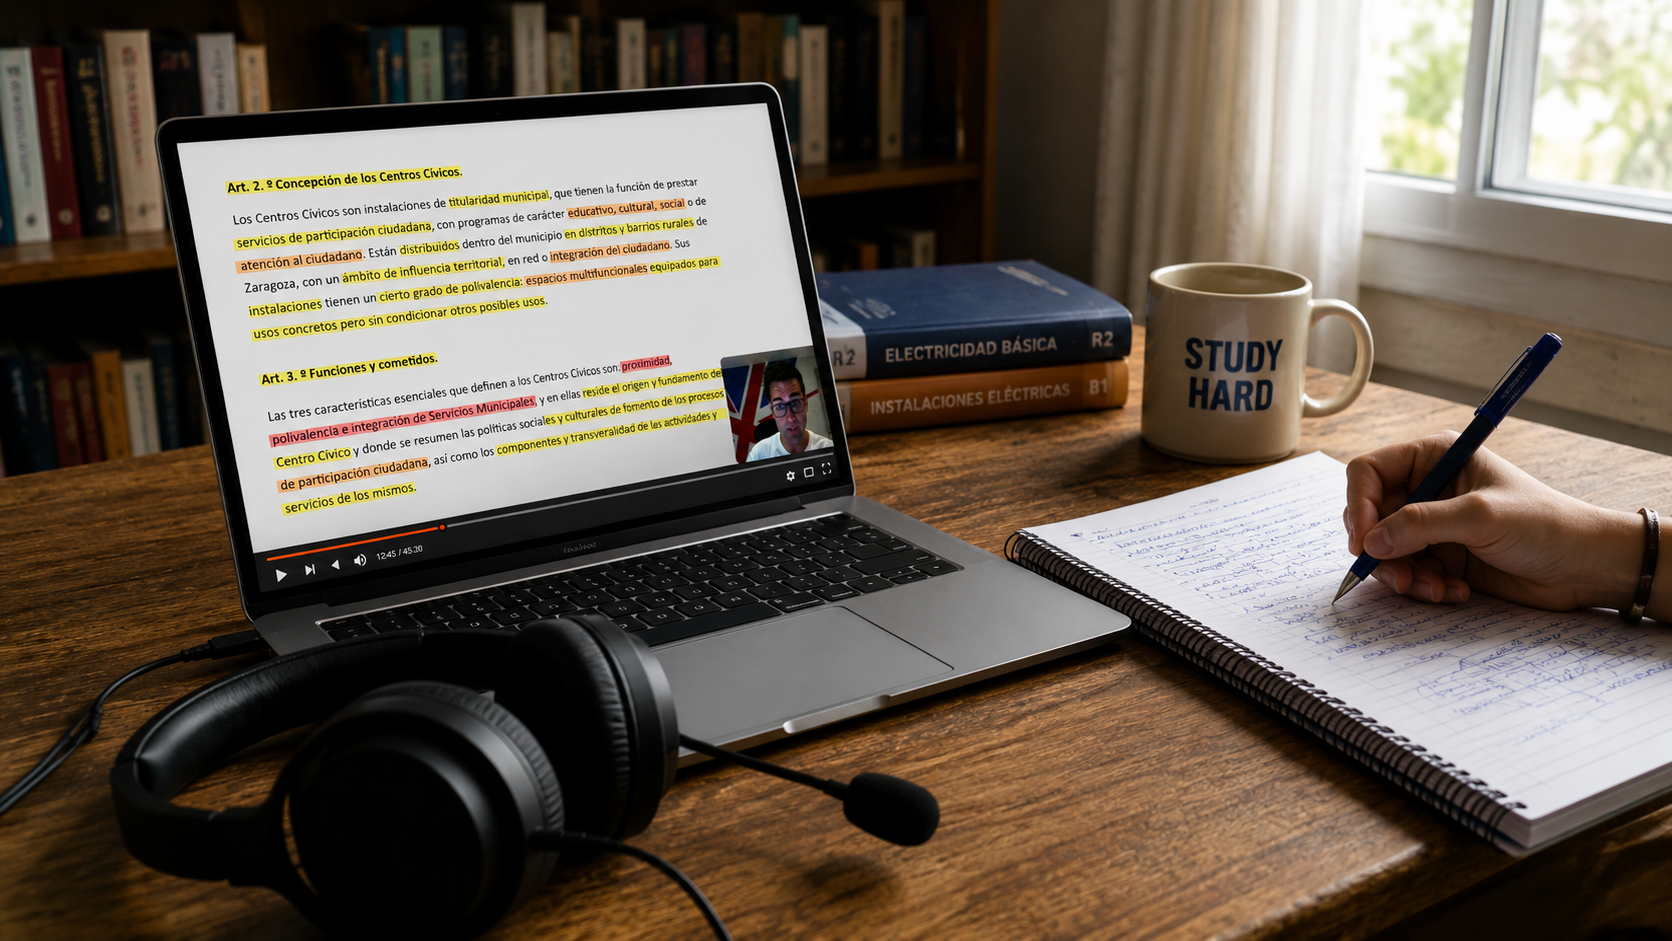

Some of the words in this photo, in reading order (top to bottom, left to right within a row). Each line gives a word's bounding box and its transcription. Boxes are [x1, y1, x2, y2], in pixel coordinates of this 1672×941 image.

[227, 181, 250, 194] Art.
[251, 180, 264, 192] 2.
[274, 174, 342, 190] Concepción
[343, 173, 359, 185] de
[359, 172, 378, 184] los
[378, 170, 422, 182] Centros
[232, 214, 253, 226] Los
[254, 211, 300, 224] Centros
[341, 206, 362, 217] son
[363, 200, 432, 214] instalaciones
[432, 197, 447, 209] de
[447, 192, 501, 207] titularidad
[501, 189, 553, 203] municipal,
[553, 189, 573, 201] que
[573, 186, 604, 197] tienen
[604, 183, 615, 194] la
[615, 180, 651, 193] función
[652, 179, 665, 190] de
[665, 178, 698, 191] prestar
[236, 234, 286, 249] servicios
[287, 232, 303, 244] de
[304, 225, 376, 245] participación
[377, 221, 435, 235] ciudadana,
[436, 220, 456, 230] con
[457, 215, 511, 231] programas
[511, 212, 525, 223] de
[525, 209, 566, 222] carácter
[567, 205, 617, 218] educativo,
[618, 200, 658, 213] cultural,
[659, 198, 685, 210] social
[686, 199, 694, 207] o
[694, 196, 707, 206] de
[240, 256, 291, 271] atención
[292, 254, 303, 266] al
[304, 250, 366, 265] ciudadano.
[367, 245, 397, 259] Están
[399, 240, 460, 255] distribuidos
[461, 237, 496, 250] dentro
[497, 233, 514, 246] del
[514, 230, 563, 244] municipio
[563, 230, 577, 239] en
[618, 225, 625, 236] y
[625, 221, 661, 233] barrios
[661, 217, 695, 230] rurales
[695, 215, 708, 226] de
[243, 279, 300, 294] Zaragoza,
[301, 277, 323, 288] con
[324, 275, 340, 285] un
[341, 269, 381, 283] ámbito
[383, 267, 398, 279] de
[399, 262, 451, 277] influencia
[452, 255, 506, 272] territorial,
[506, 256, 521, 266] en
[521, 252, 540, 264] red
[540, 253, 549, 263] o
[549, 246, 604, 262] integración
[605, 244, 621, 256] del
[622, 241, 673, 254] ciudadano.
[673, 238, 691, 249] Sus
[248, 300, 323, 316] instalaciones
[323, 295, 361, 308] tienen
[362, 294, 377, 304] un
[378, 290, 411, 302] cierto
[412, 285, 443, 301] grado
[444, 283, 459, 295] de
[460, 277, 523, 295] polivalencia:
[525, 272, 568, 287] espacios
[568, 263, 648, 281] multifuncionales
[649, 258, 697, 273] equipados
[697, 257, 719, 269] para
[253, 328, 280, 339] usos
[282, 321, 338, 336] concretos
[339, 318, 366, 332] pero
[367, 314, 384, 327] sin
[385, 308, 448, 324] condicionar
[449, 304, 478, 316] otros
[478, 298, 521, 315] posibles
[521, 297, 549, 308] usos.
[1091, 330, 1114, 348] R2
[261, 373, 284, 385] Art.
[285, 370, 298, 382] 3.
[308, 363, 367, 379] Funciones
[368, 362, 376, 374] y
[377, 353, 438, 370] cometidos.
[885, 341, 997, 363] ELECTRICIDAD
[1001, 335, 1058, 355] BÁSICA
[1184, 337, 1283, 373] STUDY
[267, 411, 287, 422] Las
[287, 407, 312, 419] tres
[393, 387, 448, 405] esenciales
[448, 385, 469, 398] que
[470, 380, 508, 394] definen
[509, 379, 516, 388] a
[516, 375, 532, 386] los
[532, 371, 570, 384] Centros
[621, 356, 673, 373] proximidad,
[870, 391, 984, 415] INSTALACIONES
[987, 383, 1071, 405] ELÉCTRICAS
[1089, 379, 1108, 395] B1
[1188, 376, 1274, 412] HARD
[271, 425, 340, 448] polivalencia
[340, 425, 349, 435] e
[350, 414, 411, 433] integración
[412, 412, 427, 424] de
[427, 406, 474, 422] Servicios
[475, 396, 538, 414] Municipales,
[538, 396, 545, 407] y
[545, 393, 559, 403] en
[559, 389, 582, 401] ellas
[581, 384, 610, 398] reside
[610, 382, 621, 394] el
[621, 380, 650, 393] origen
[650, 379, 657, 389] y
[656, 371, 710, 387] fundamento
[275, 454, 316, 468] Centro
[351, 446, 360, 458] y
[361, 439, 397, 455] donde
[398, 438, 411, 449] se
[413, 431, 459, 446] resumen
[460, 427, 476, 439] las
[476, 422, 518, 438] políticas
[518, 415, 557, 430] sociales
[556, 415, 564, 425] y
[564, 406, 609, 422] culturales
[609, 404, 622, 415] de
[622, 399, 660, 413] fomento
[660, 396, 673, 407] de
[673, 395, 687, 405] los
[687, 390, 725, 405] procesos
[279, 478, 296, 491] de
[297, 466, 371, 490] participación
[372, 458, 432, 476] ciudadana,
[449, 450, 479, 463] como
[479, 447, 495, 458] los
[496, 436, 562, 455] componentes
[562, 435, 569, 446] y
[636, 421, 649, 432] de
[663, 411, 711, 427] actividades
[711, 411, 718, 421] y
[284, 496, 335, 514] servicios
[336, 492, 352, 505] de
[352, 490, 370, 502] los
[371, 483, 417, 499] mismos.
